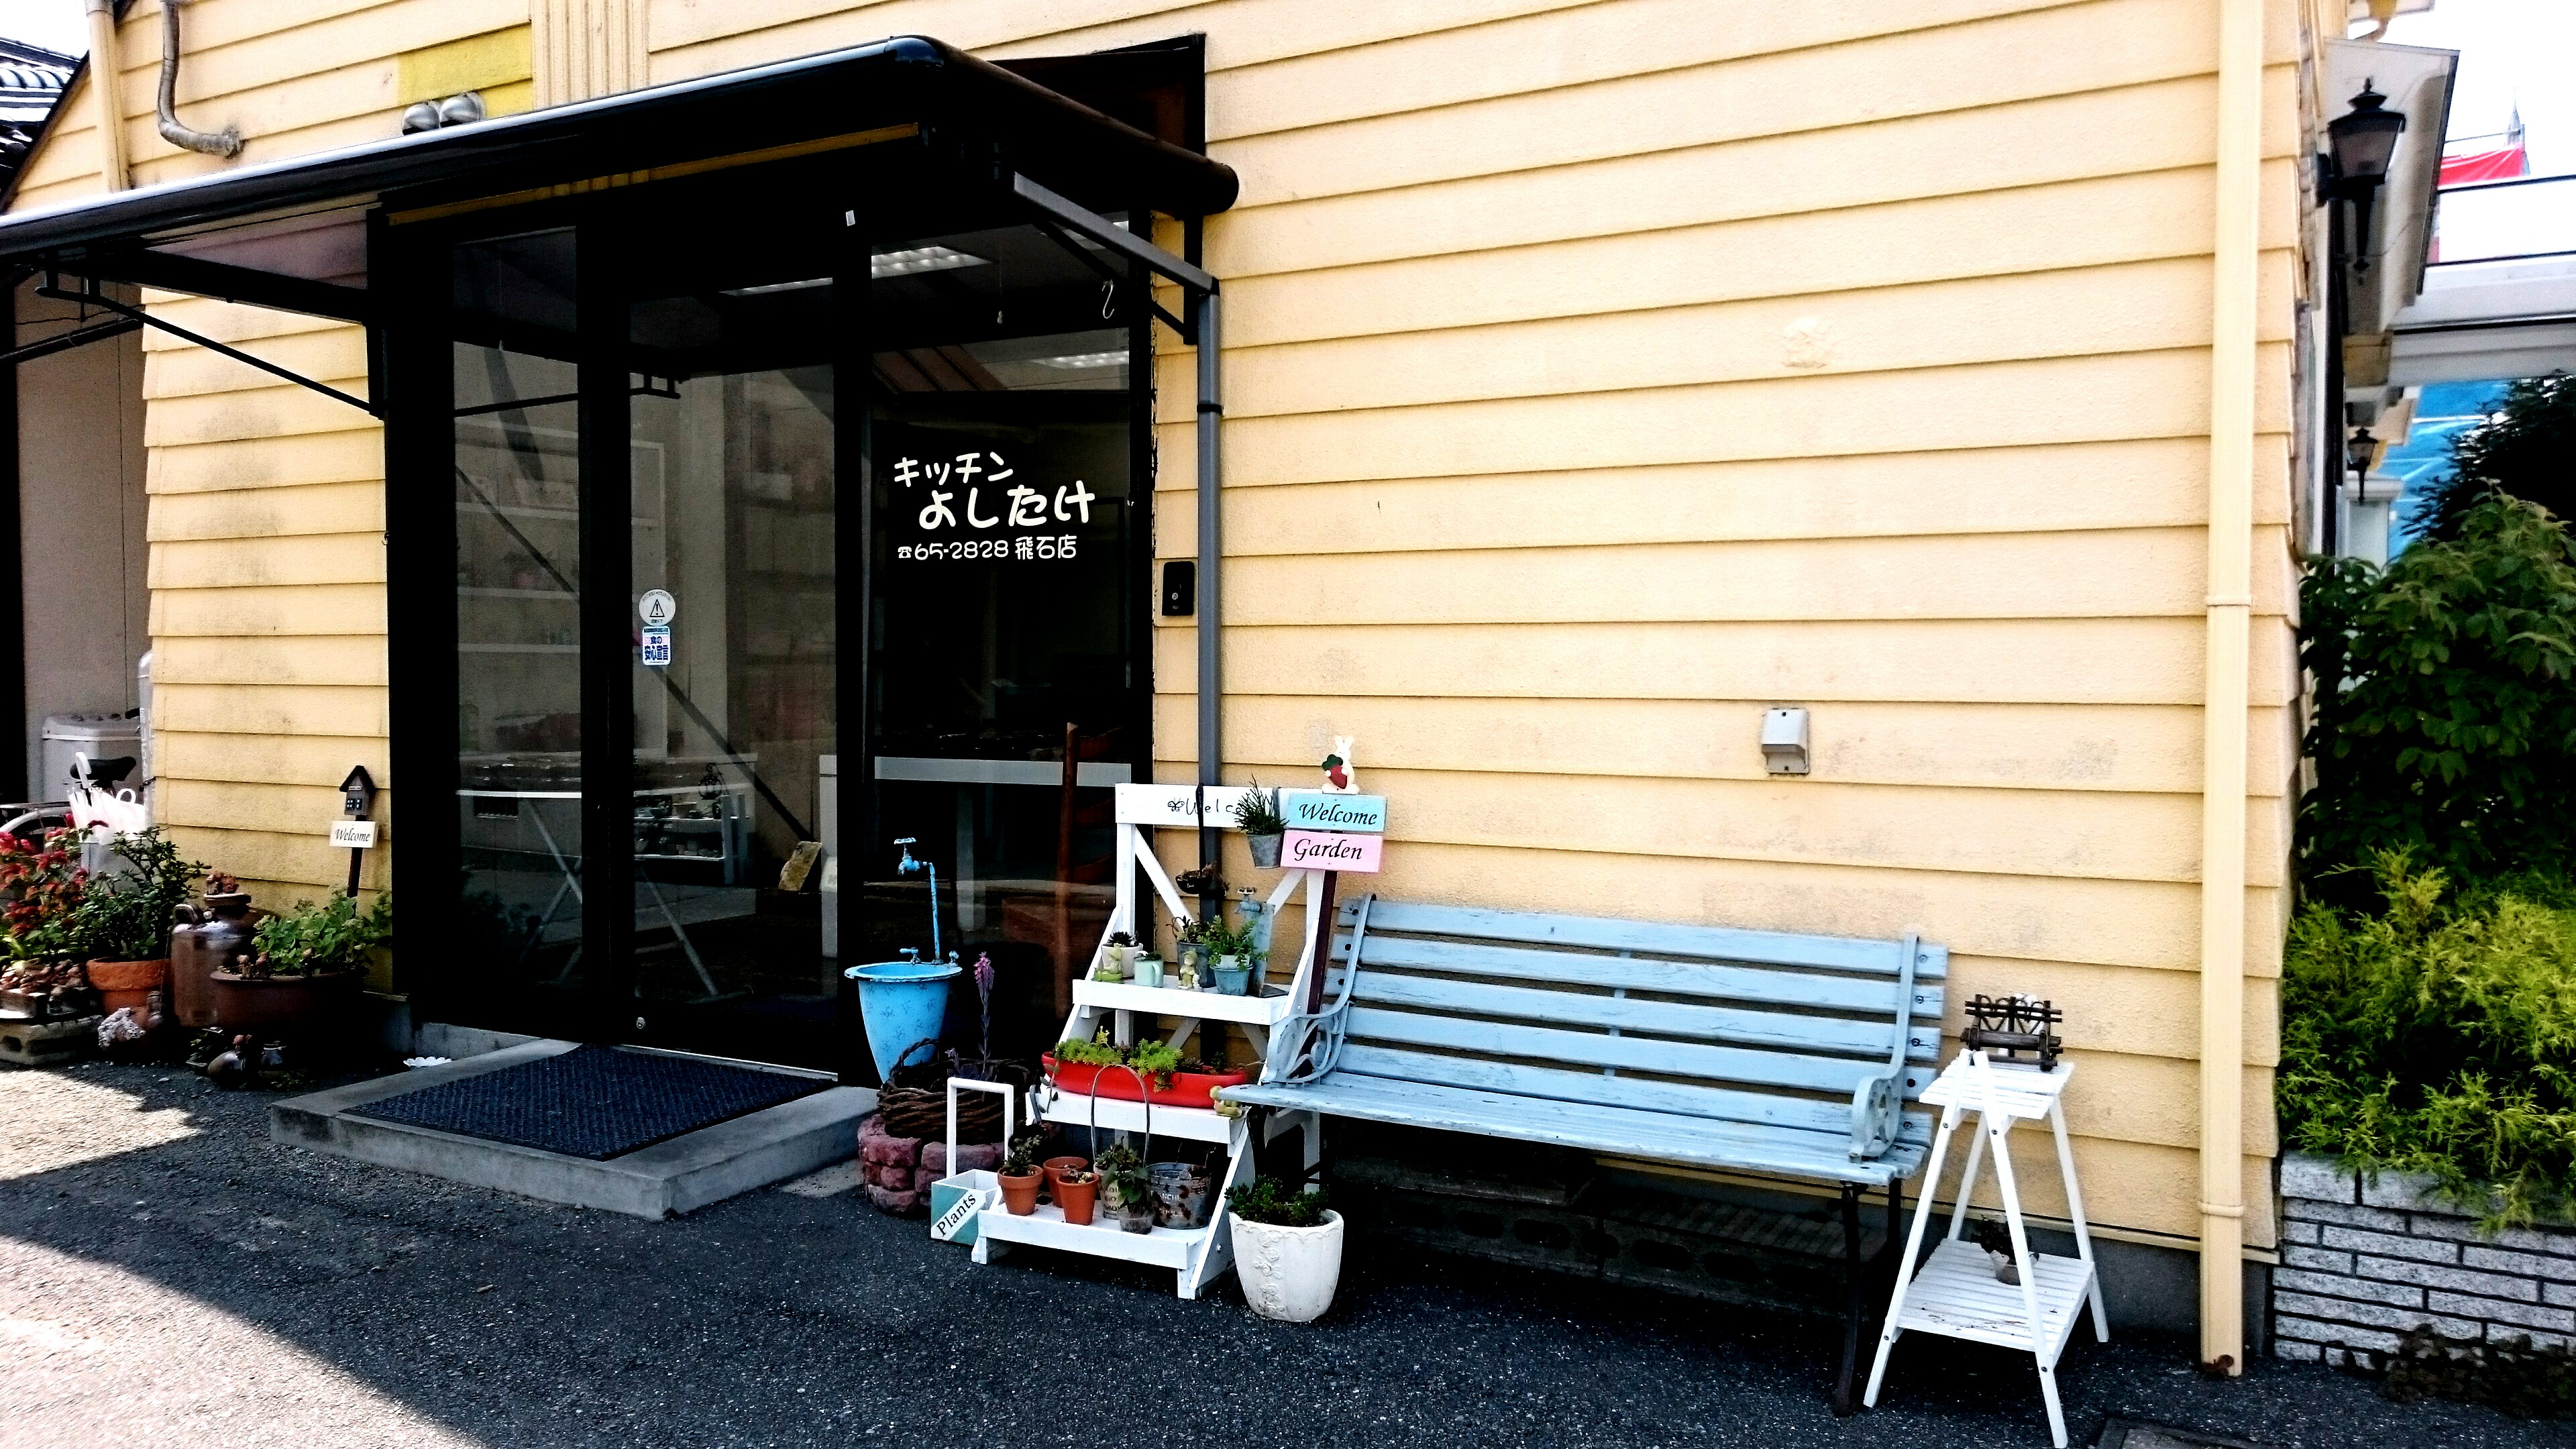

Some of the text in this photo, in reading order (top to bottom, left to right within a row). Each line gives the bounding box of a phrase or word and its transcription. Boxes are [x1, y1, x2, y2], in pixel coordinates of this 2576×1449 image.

[894, 451, 1014, 487] キッチン
[919, 480, 1095, 529] よしたけ
[1015, 534, 1077, 559] 飛石店
[1185, 798, 1242, 815] Welco
[1299, 802, 1377, 824] Welcome
[335, 828, 370, 842] Welcome
[1294, 839, 1362, 861] Garden
[936, 1194, 976, 1237] Plants
